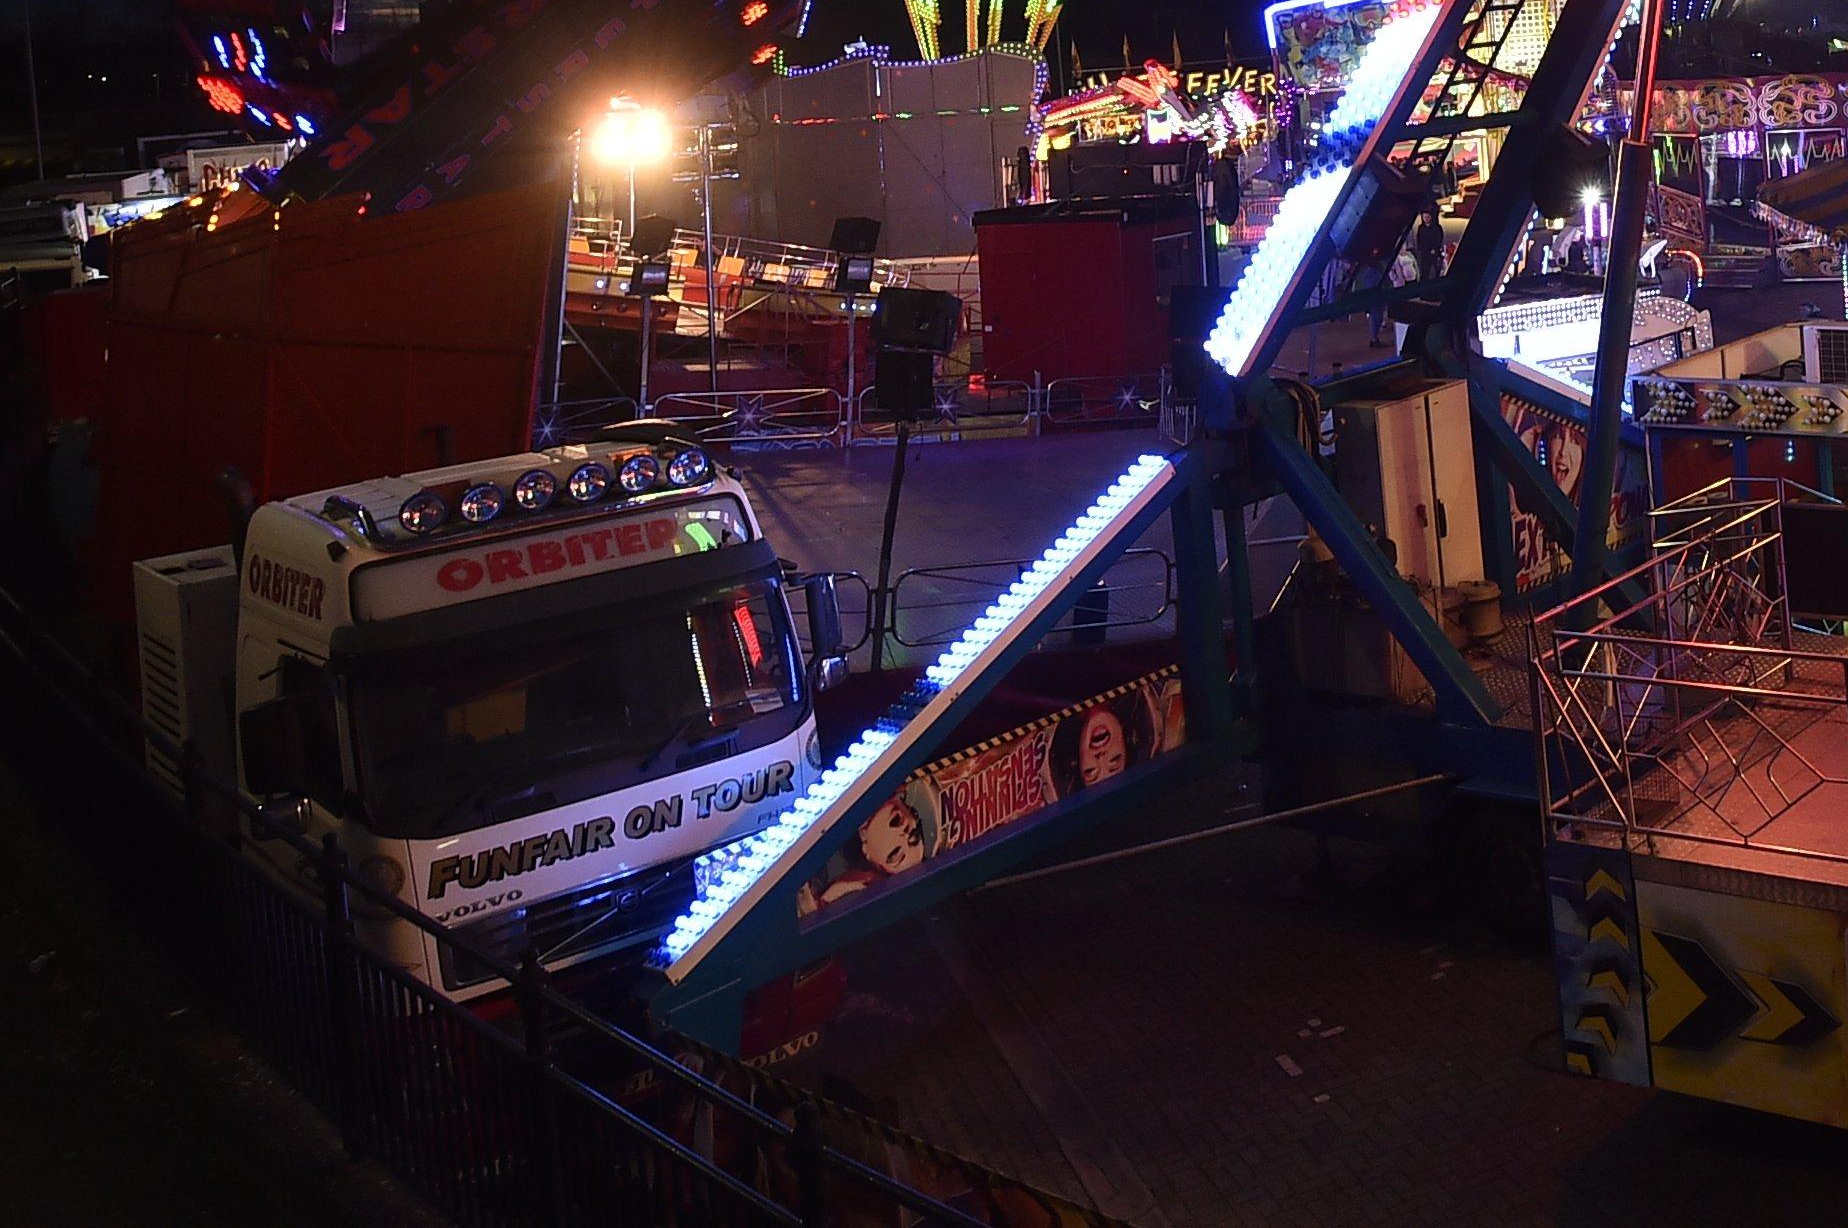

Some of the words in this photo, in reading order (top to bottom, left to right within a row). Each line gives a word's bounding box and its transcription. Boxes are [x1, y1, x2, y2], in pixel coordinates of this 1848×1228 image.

[1186, 66, 1277, 95] FEVER
[249, 554, 324, 620] ORBITER
[437, 518, 678, 592] ORBITER
[939, 732, 1047, 830] SENSATION
[947, 775, 1043, 843] SPINNING
[427, 816, 615, 899] FUNFAIR
[625, 795, 683, 839] ON
[693, 760, 794, 818] TOUR
[435, 889, 523, 922] VOLVO
